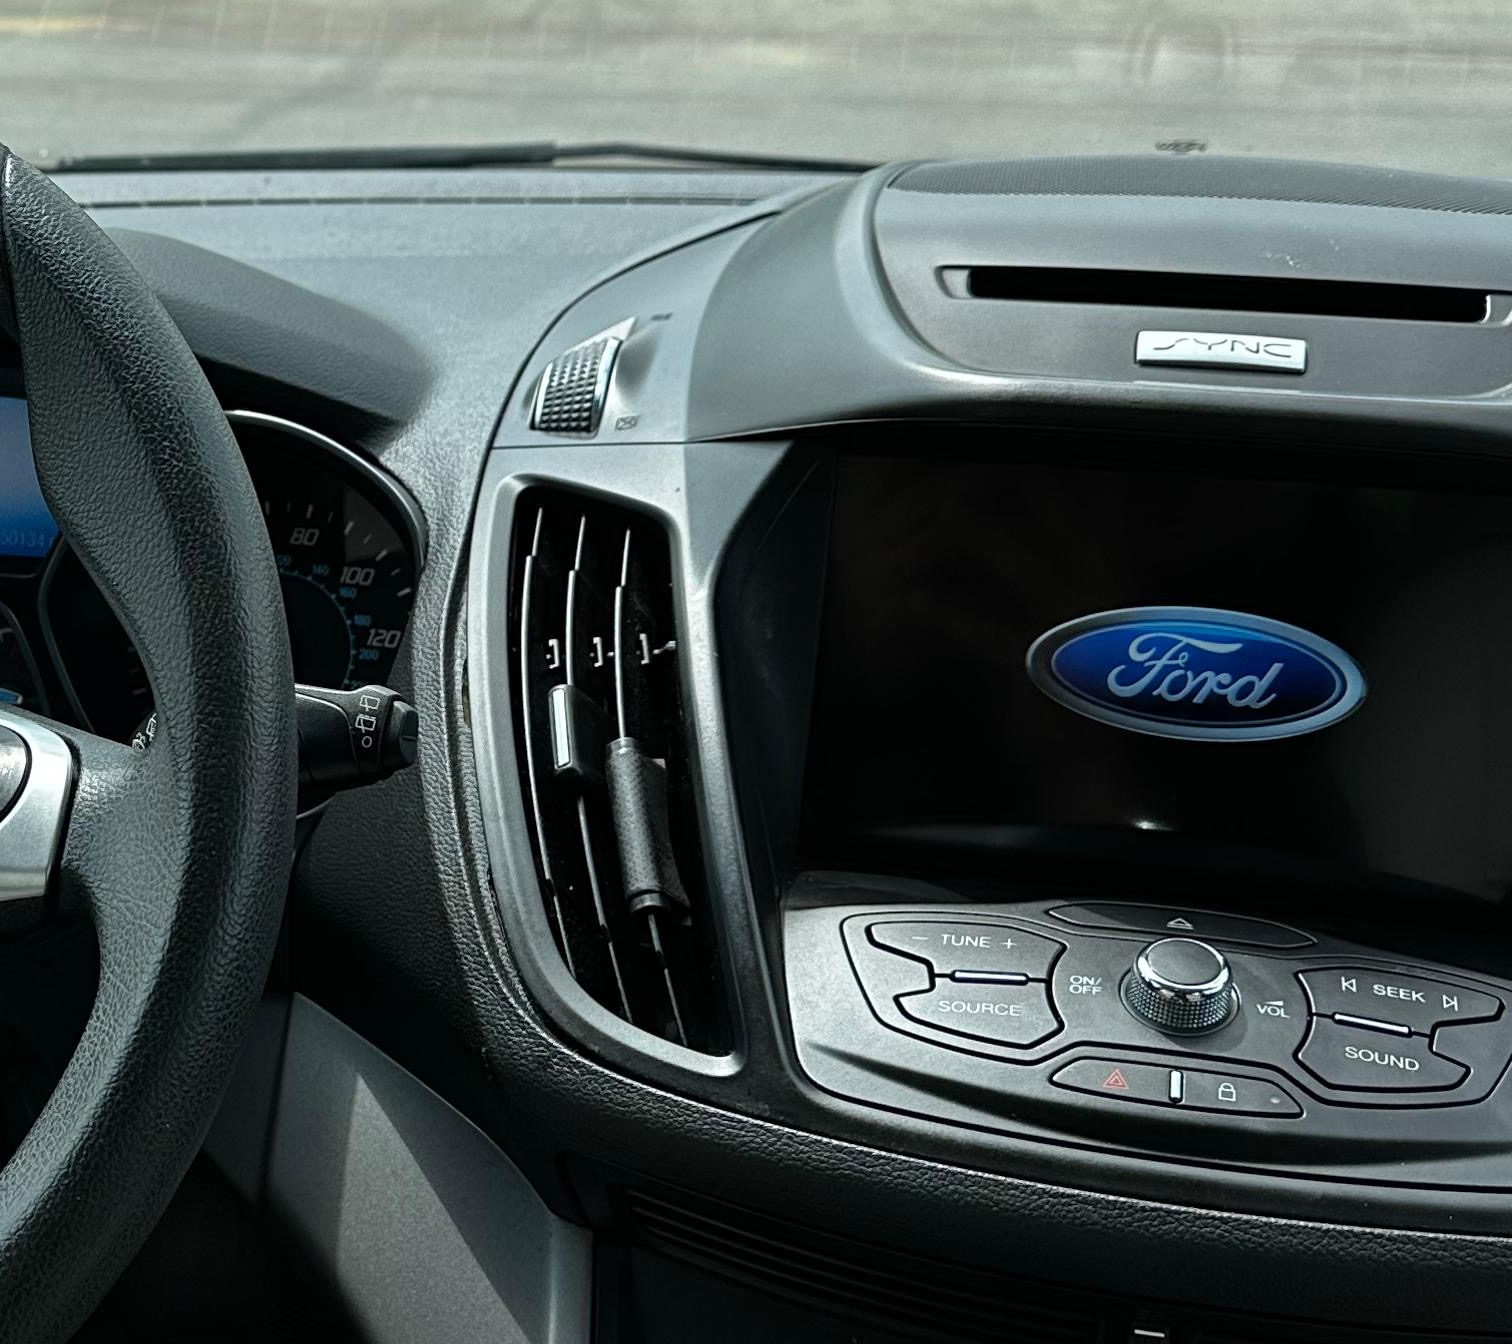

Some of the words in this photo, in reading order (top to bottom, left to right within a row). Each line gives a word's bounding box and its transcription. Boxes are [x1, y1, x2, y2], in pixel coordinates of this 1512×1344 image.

[1152, 336, 1293, 359] SYNC
[289, 528, 320, 546] 80
[340, 566, 376, 587] 100
[367, 629, 402, 649] 120
[1106, 631, 1284, 709] Ford
[941, 934, 992, 949] TUNE
[1069, 984, 1104, 995] OFF
[1373, 984, 1426, 1003] SEEK
[938, 1000, 1024, 1017] SOURCE
[1256, 1004, 1290, 1019] VOL
[1344, 1046, 1420, 1071] SOUND
